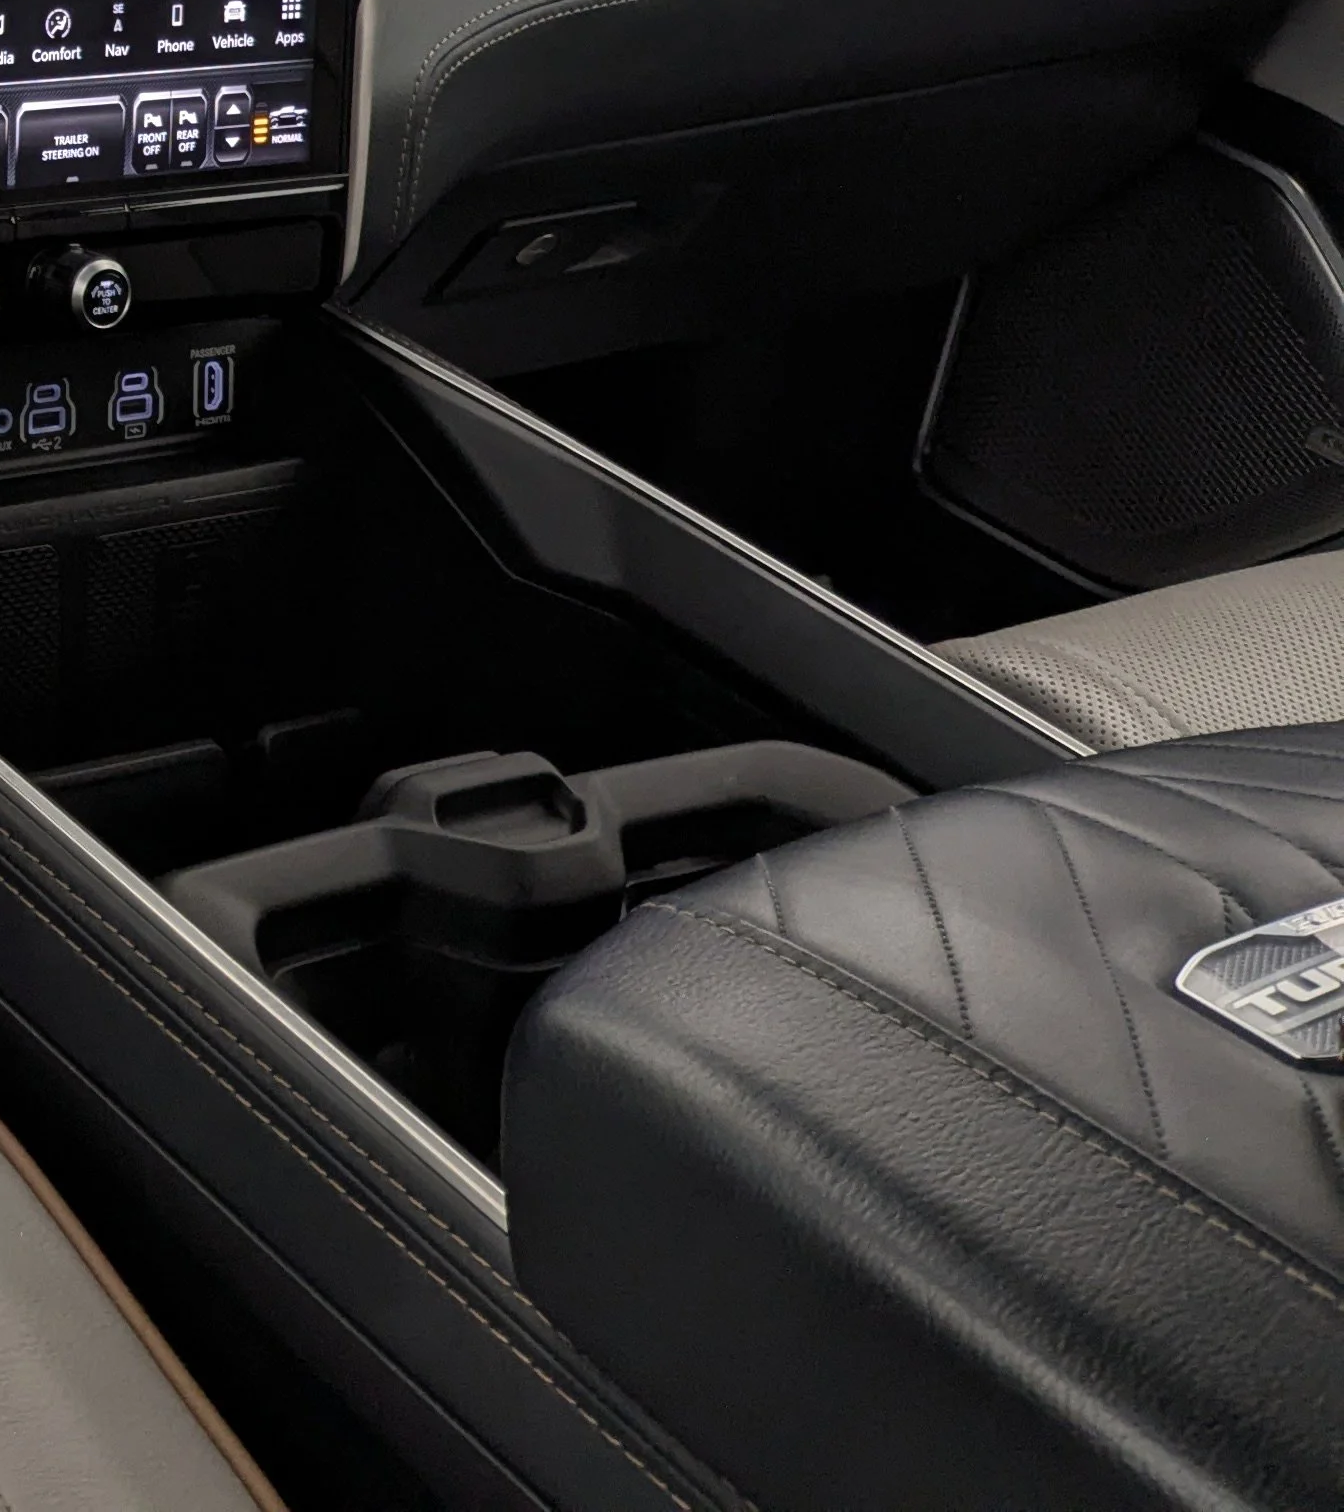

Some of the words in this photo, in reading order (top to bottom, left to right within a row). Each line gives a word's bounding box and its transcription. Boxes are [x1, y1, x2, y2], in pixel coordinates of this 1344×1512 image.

[113, 3, 124, 14] SE
[32, 46, 82, 62] Comfort
[105, 43, 130, 57] Nav
[157, 39, 195, 53] Phone
[212, 33, 254, 49] Vehicle
[275, 32, 304, 46] Apps
[54, 134, 89, 146] TRAILER
[138, 132, 167, 144] FRONT
[177, 129, 199, 141] REAR
[271, 133, 303, 144] NORMAL
[42, 148, 85, 161] STEERING
[85, 146, 100, 157] ON
[143, 145, 160, 156] OFF
[179, 142, 196, 153] OFF
[97, 290, 115, 298] PUSH
[93, 305, 118, 315] CENTER
[190, 345, 236, 359] PASSENGER
[53, 437, 62, 450] 2
